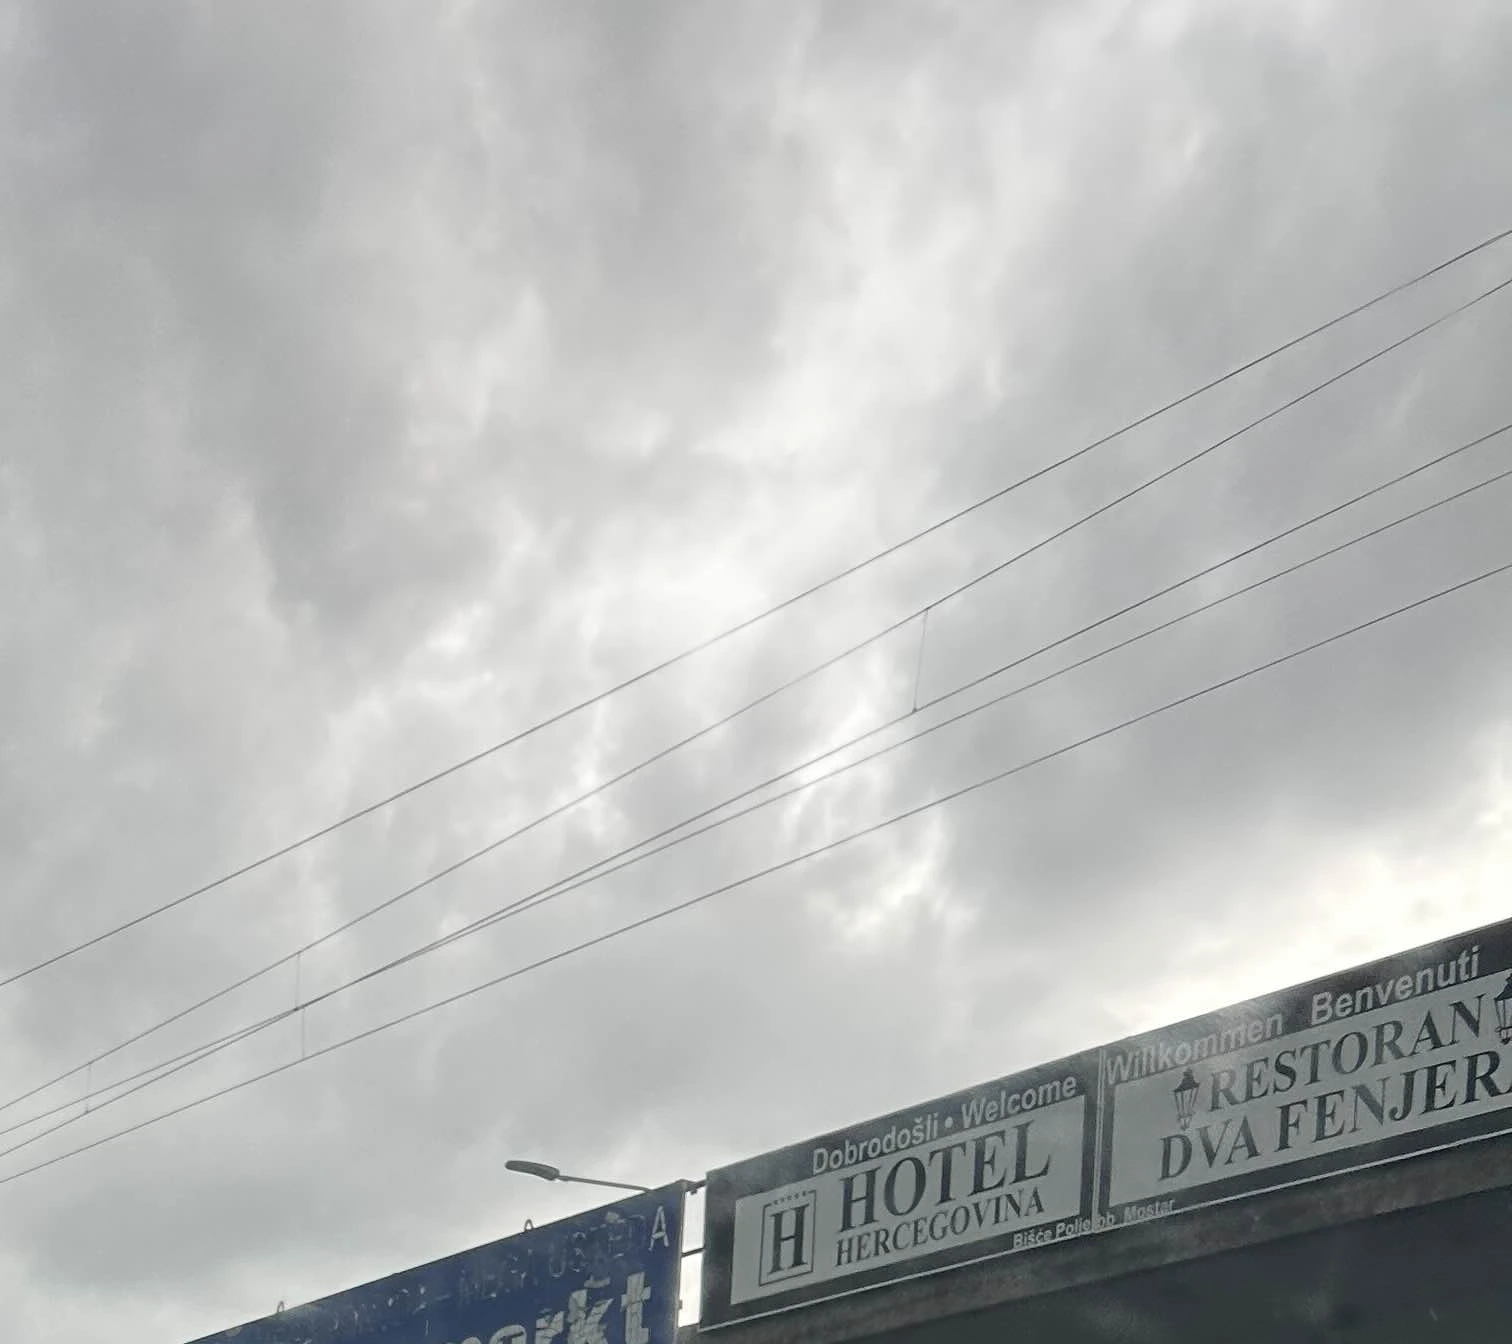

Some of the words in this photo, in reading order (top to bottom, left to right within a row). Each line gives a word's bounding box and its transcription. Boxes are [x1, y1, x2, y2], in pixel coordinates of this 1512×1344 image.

[812, 1112, 939, 1176] Dobrodošli
[961, 1076, 1077, 1130] Welcome
[1104, 1012, 1285, 1086] Willkommen
[1311, 945, 1481, 1026] Benvenuti
[1209, 993, 1487, 1112] RESTORAN
[838, 1120, 1051, 1232] HOTEL
[1159, 1115, 1261, 1181] DVA
[768, 1203, 811, 1275] H
[835, 1187, 1045, 1268] HERCEGOVINA
